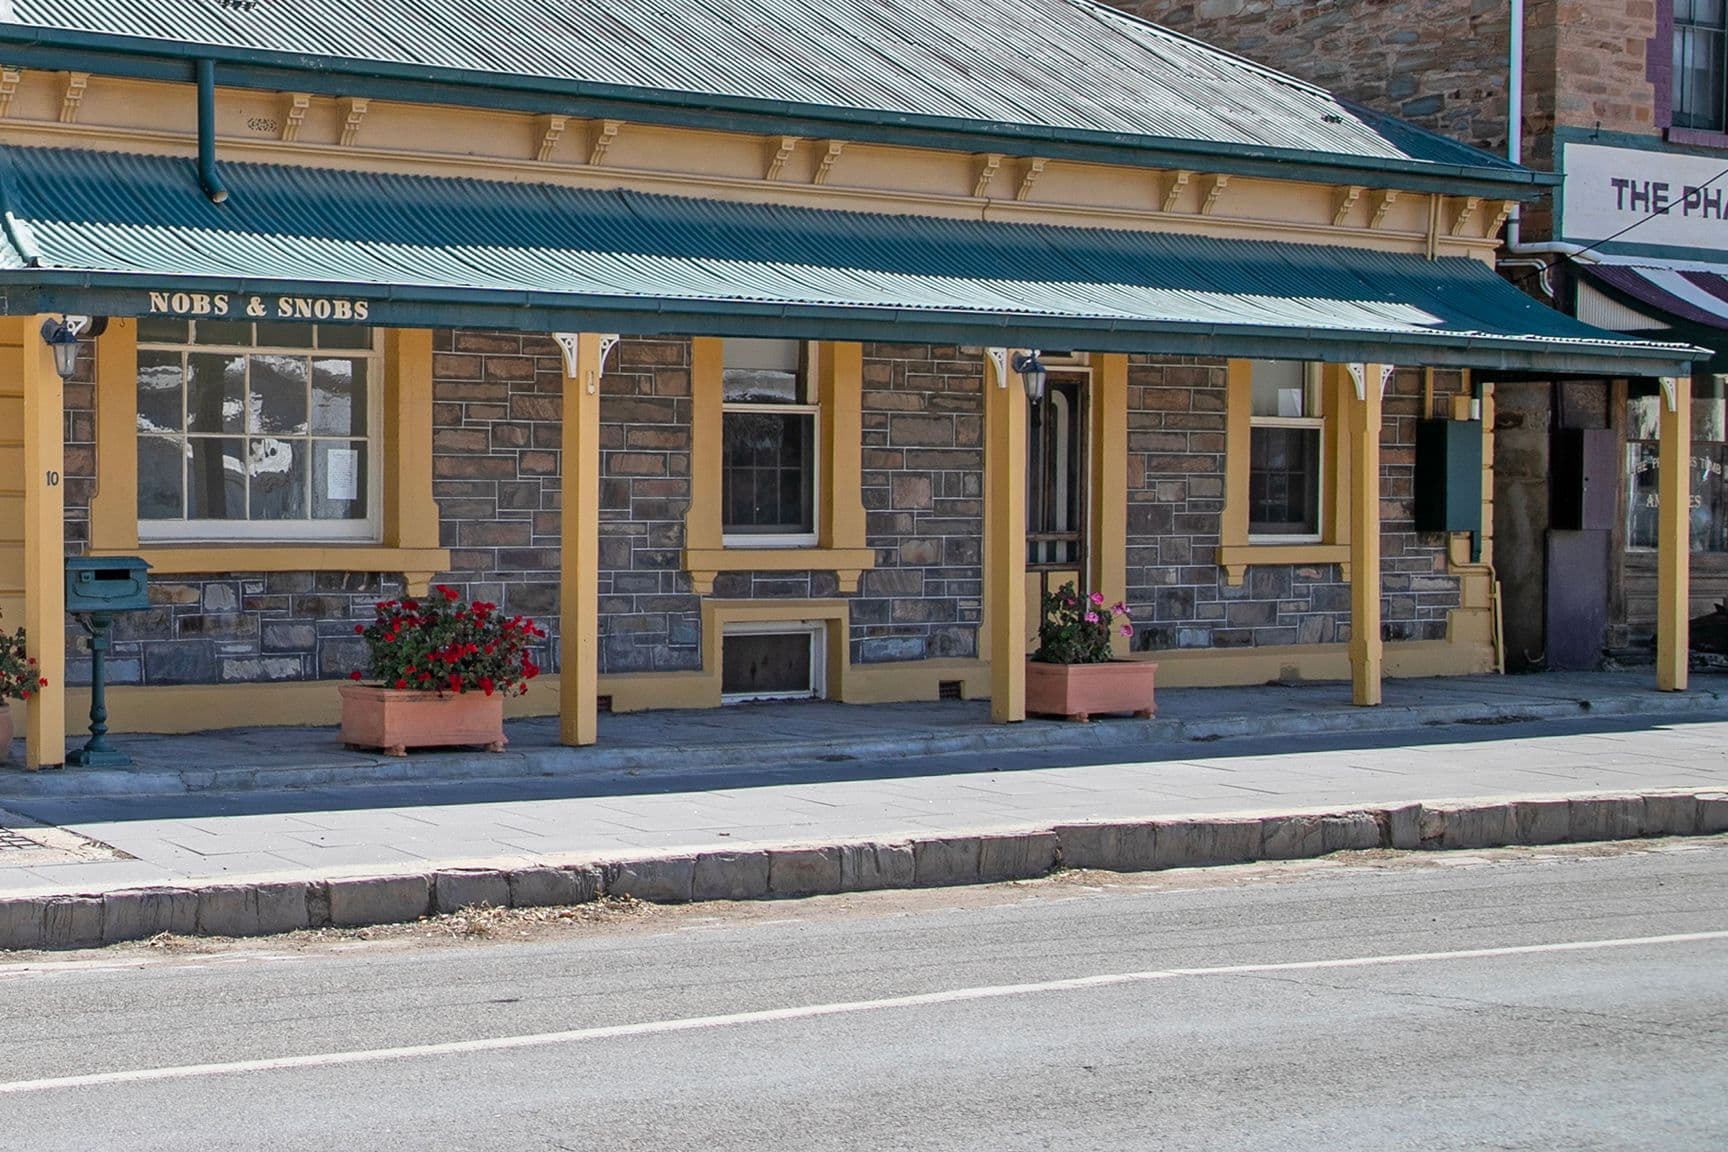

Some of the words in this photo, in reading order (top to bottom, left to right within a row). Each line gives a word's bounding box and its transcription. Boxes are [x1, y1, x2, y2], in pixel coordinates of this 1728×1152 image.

[1611, 177, 1669, 215] THE
[148, 291, 229, 315] NOBS
[246, 296, 268, 317] &
[278, 296, 369, 320] SNOBS
[46, 470, 59, 486] 10
